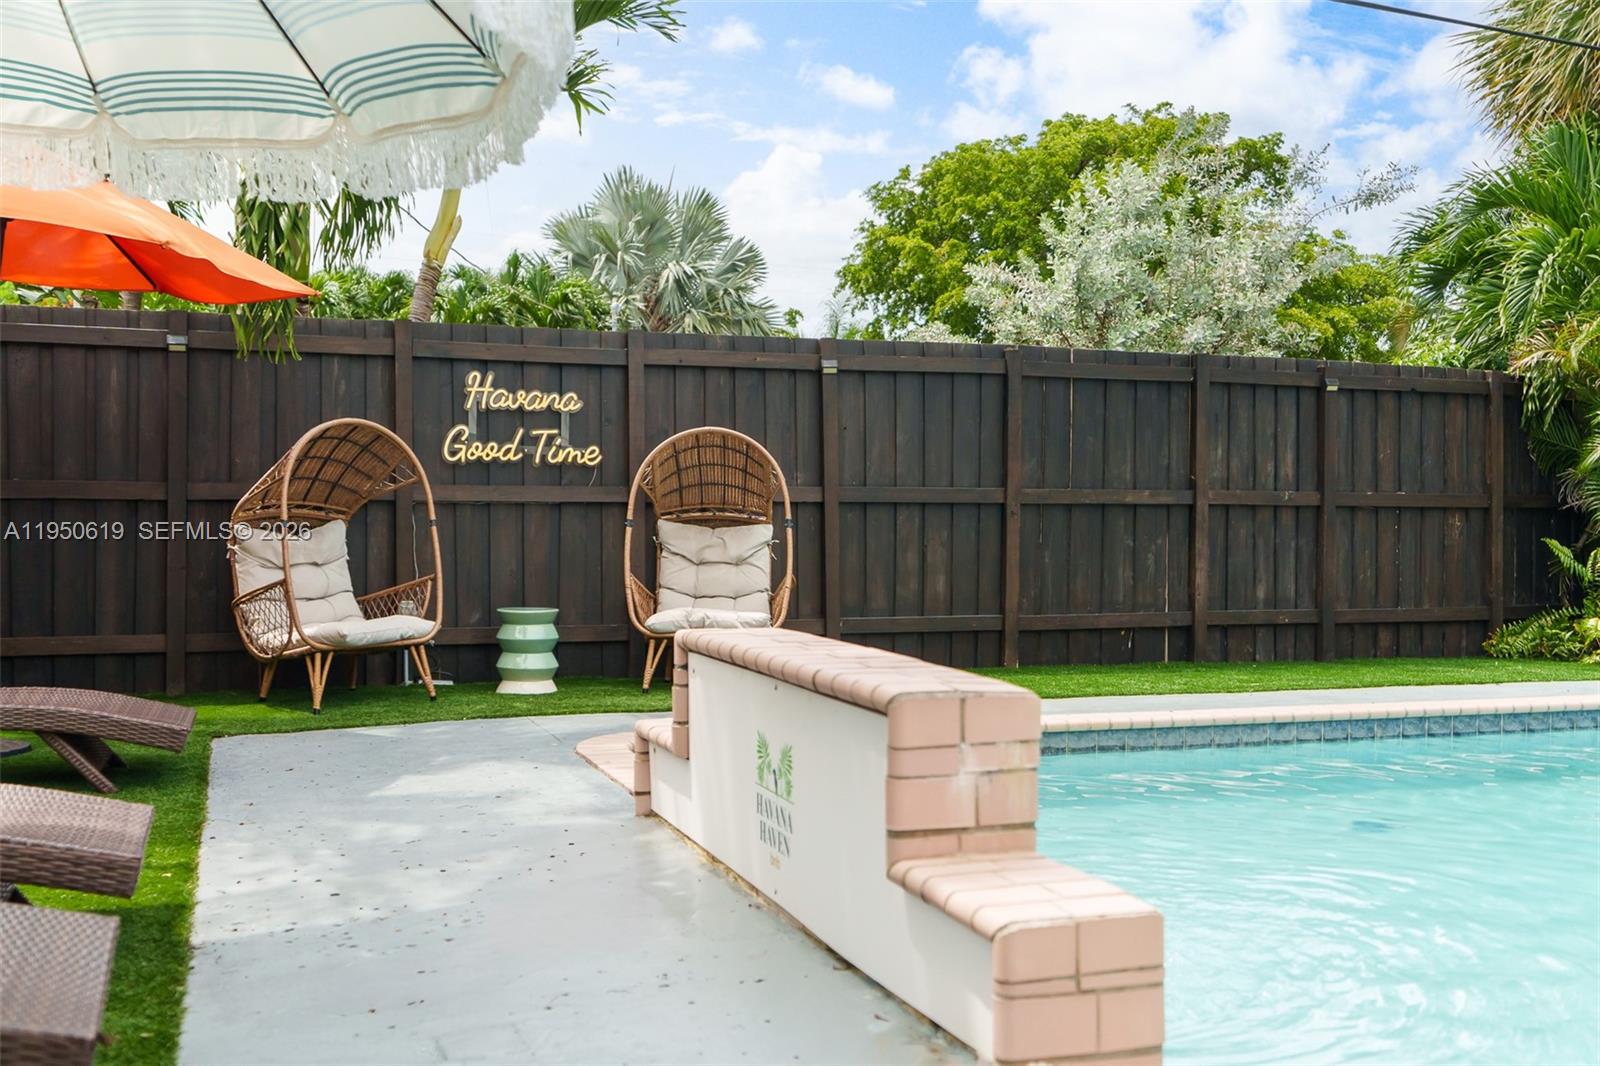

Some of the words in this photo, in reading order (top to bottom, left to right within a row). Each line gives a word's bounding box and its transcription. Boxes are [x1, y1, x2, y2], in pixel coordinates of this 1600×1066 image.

[464, 370, 583, 413] Havana
[442, 424, 525, 465] Good
[530, 429, 603, 467] Time
[756, 791, 793, 835] HAVANA
[759, 819, 791, 860] HAVEN
